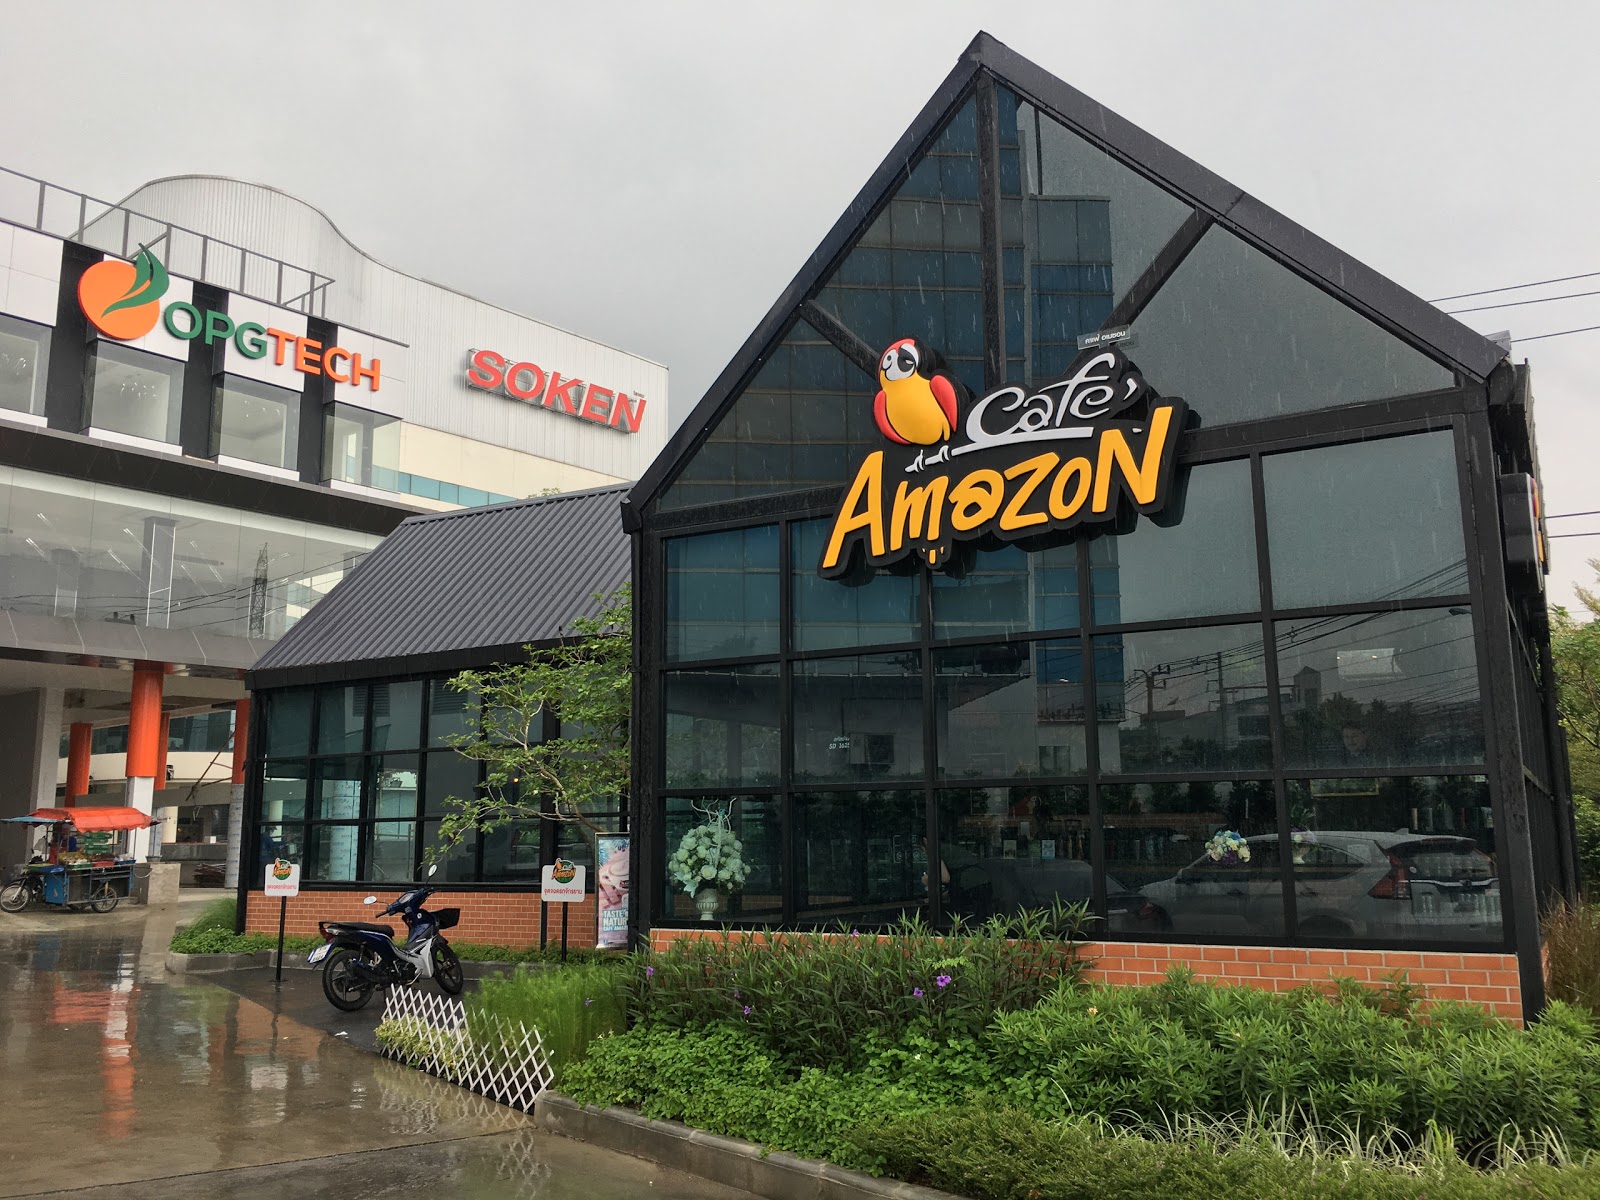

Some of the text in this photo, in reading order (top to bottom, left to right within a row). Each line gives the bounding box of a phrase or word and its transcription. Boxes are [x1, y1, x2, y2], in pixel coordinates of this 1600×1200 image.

[163, 300, 381, 392] OPGTECH
[467, 349, 647, 434] SOKEN
[602, 917, 629, 927] NATUR
